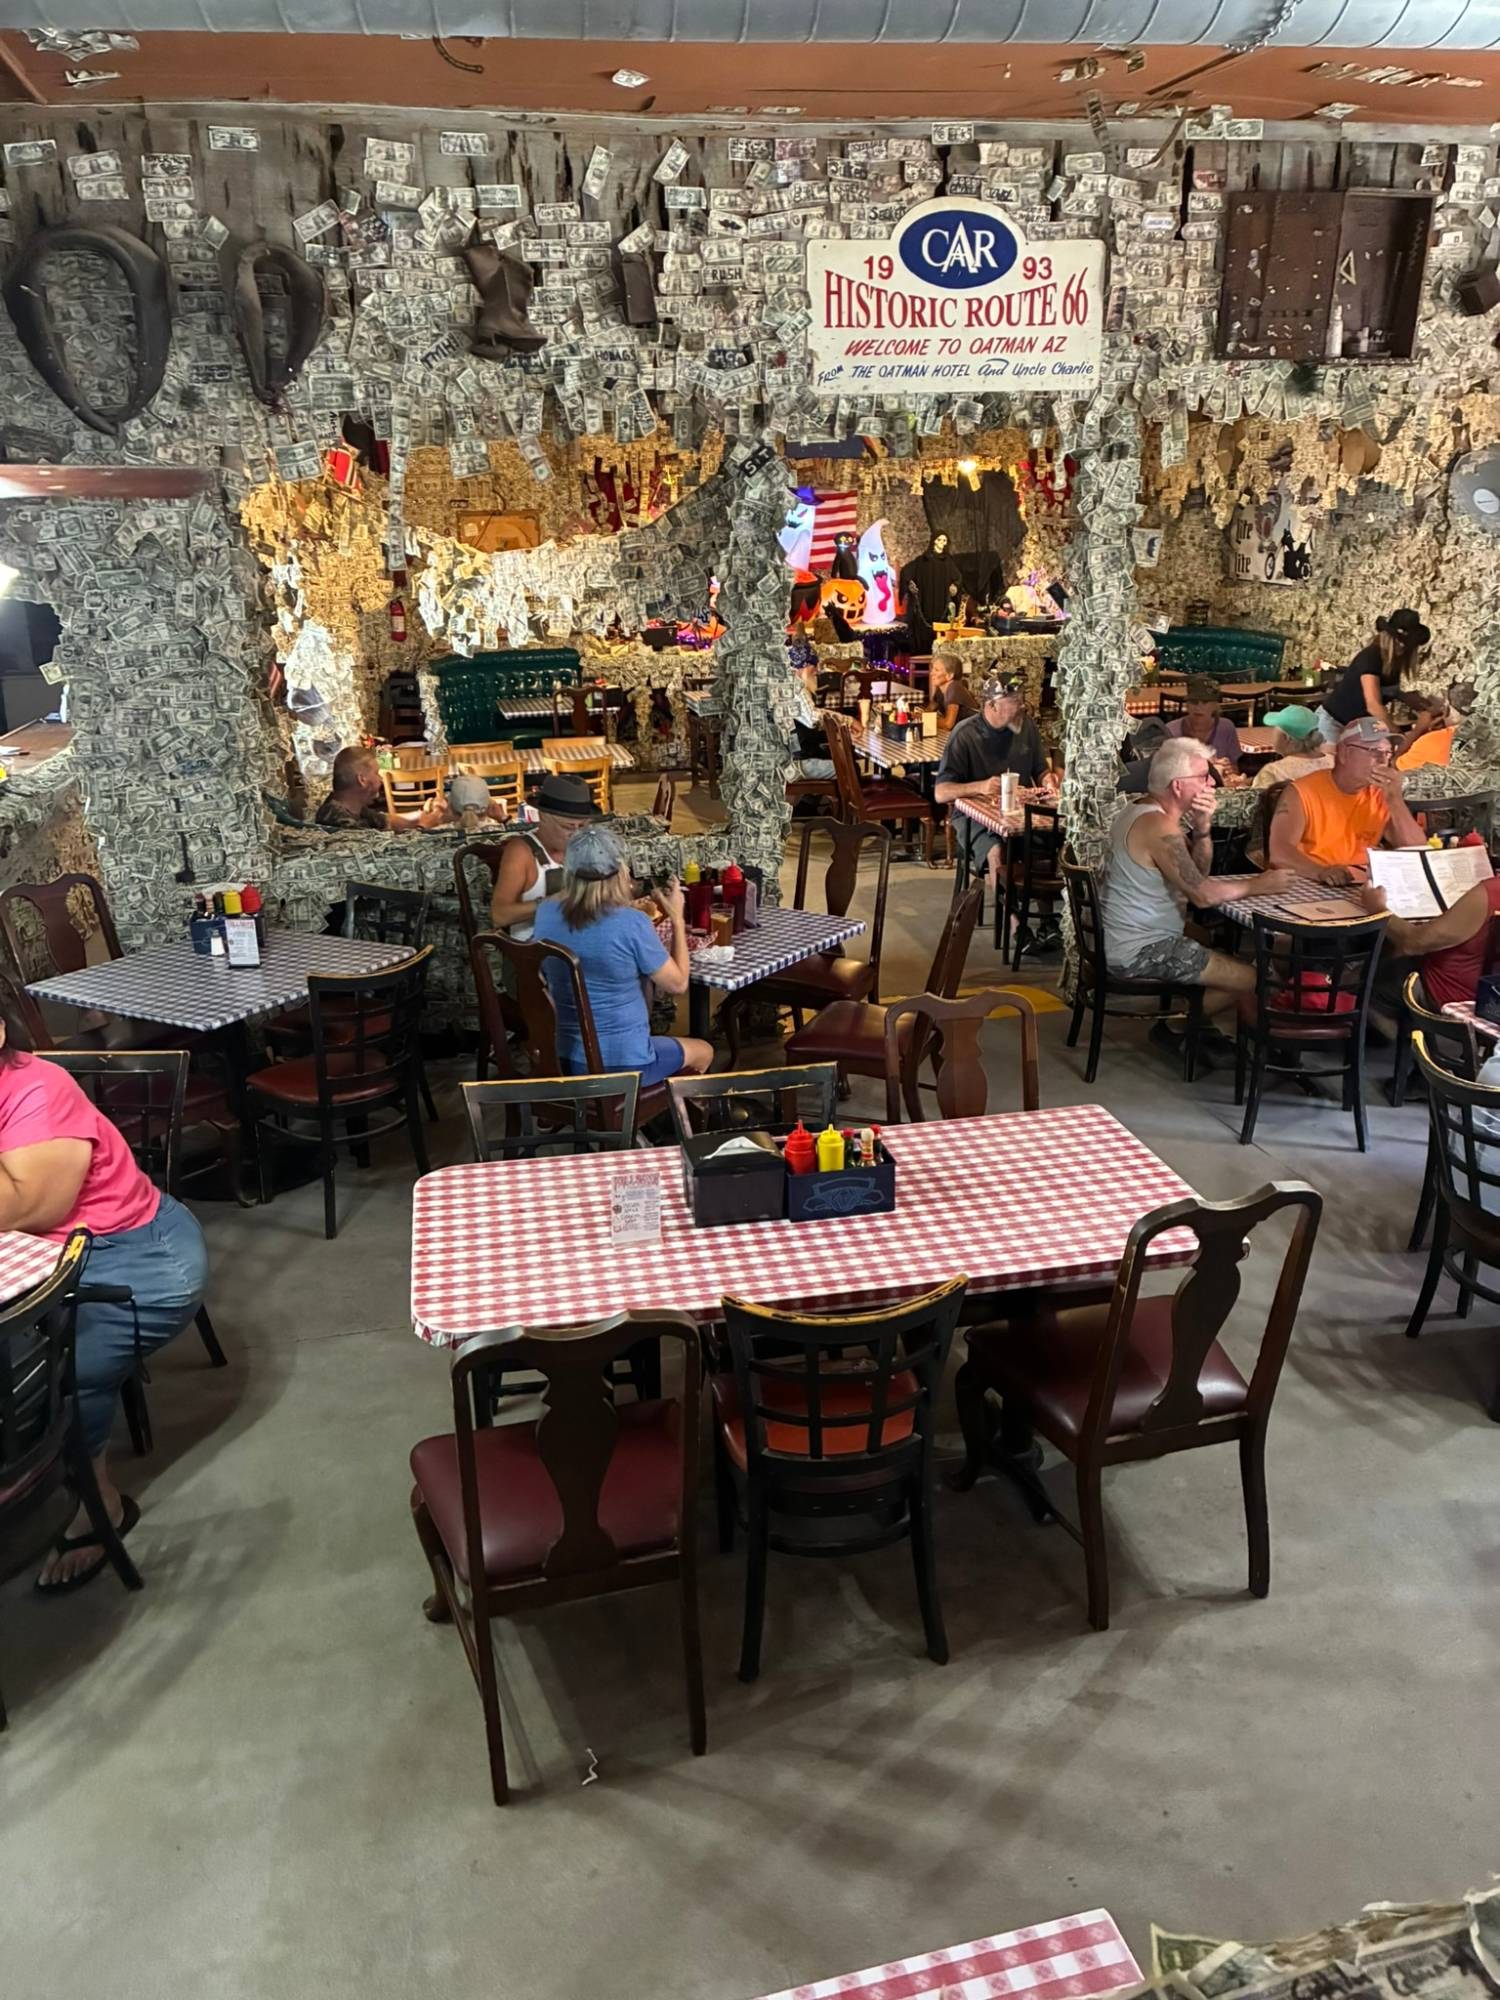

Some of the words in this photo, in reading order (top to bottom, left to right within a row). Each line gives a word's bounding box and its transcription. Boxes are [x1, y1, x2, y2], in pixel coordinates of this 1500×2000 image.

[864, 255, 893, 280] 19
[1022, 256, 1052, 280] 93
[824, 270, 958, 329] HISTORIC
[964, 282, 1058, 328] ROUTE
[1062, 267, 1088, 327] 66
[844, 338, 929, 356] WELCOME
[939, 338, 962, 355] TO
[969, 336, 1038, 354] OATMAN
[1042, 335, 1068, 353] AZ
[851, 365, 875, 378] THE
[879, 364, 928, 378] OATMAN
[932, 363, 970, 377] HOTEL
[1012, 362, 1046, 376] Uncle
[1051, 361, 1094, 376] Charlie
